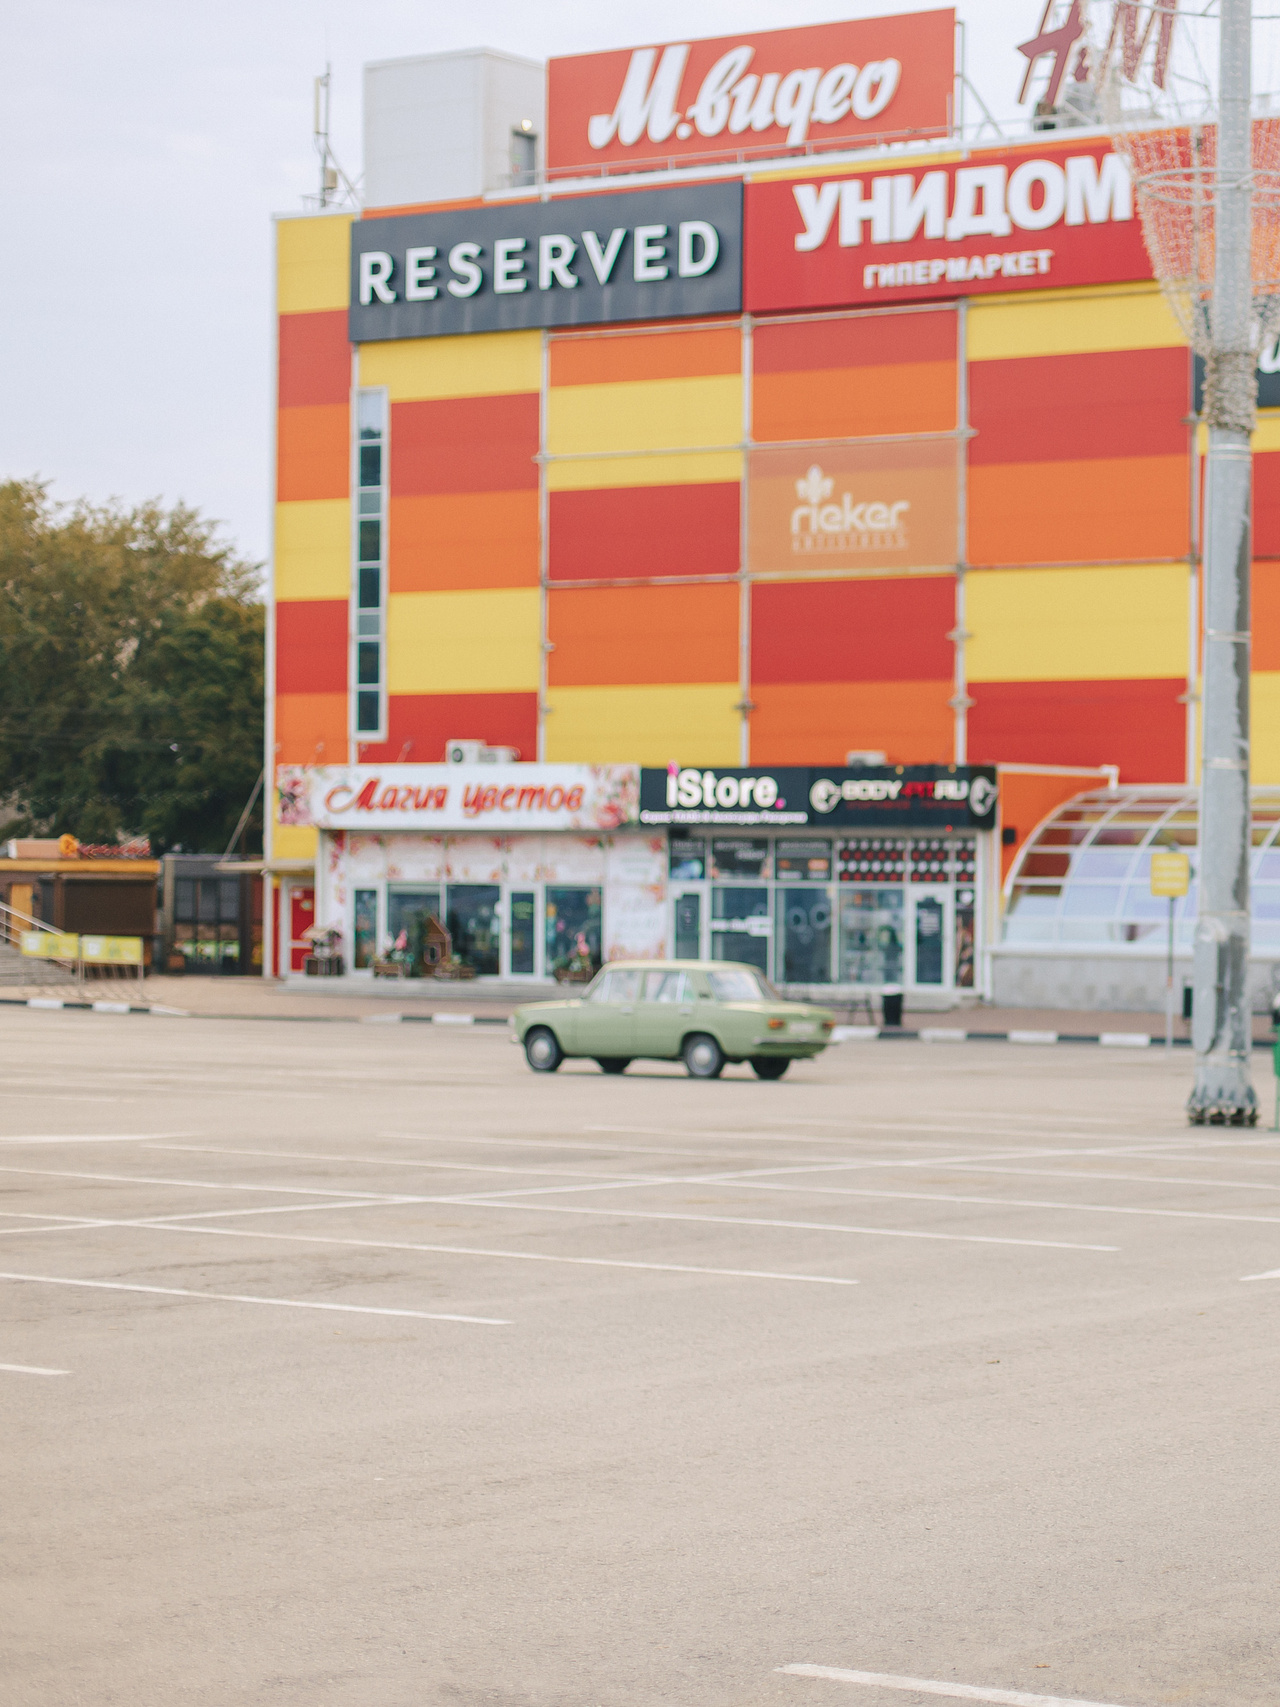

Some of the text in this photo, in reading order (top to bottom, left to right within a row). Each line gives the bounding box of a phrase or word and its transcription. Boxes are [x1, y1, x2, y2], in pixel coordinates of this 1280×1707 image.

[588, 44, 901, 145] М.видео
[792, 153, 1134, 251] УНИДОМ
[358, 220, 721, 305] RESERVED
[864, 249, 1053, 289] ГИПЕРМАРКЕТ
[791, 492, 910, 534] rieker
[463, 784, 585, 819] цветов
